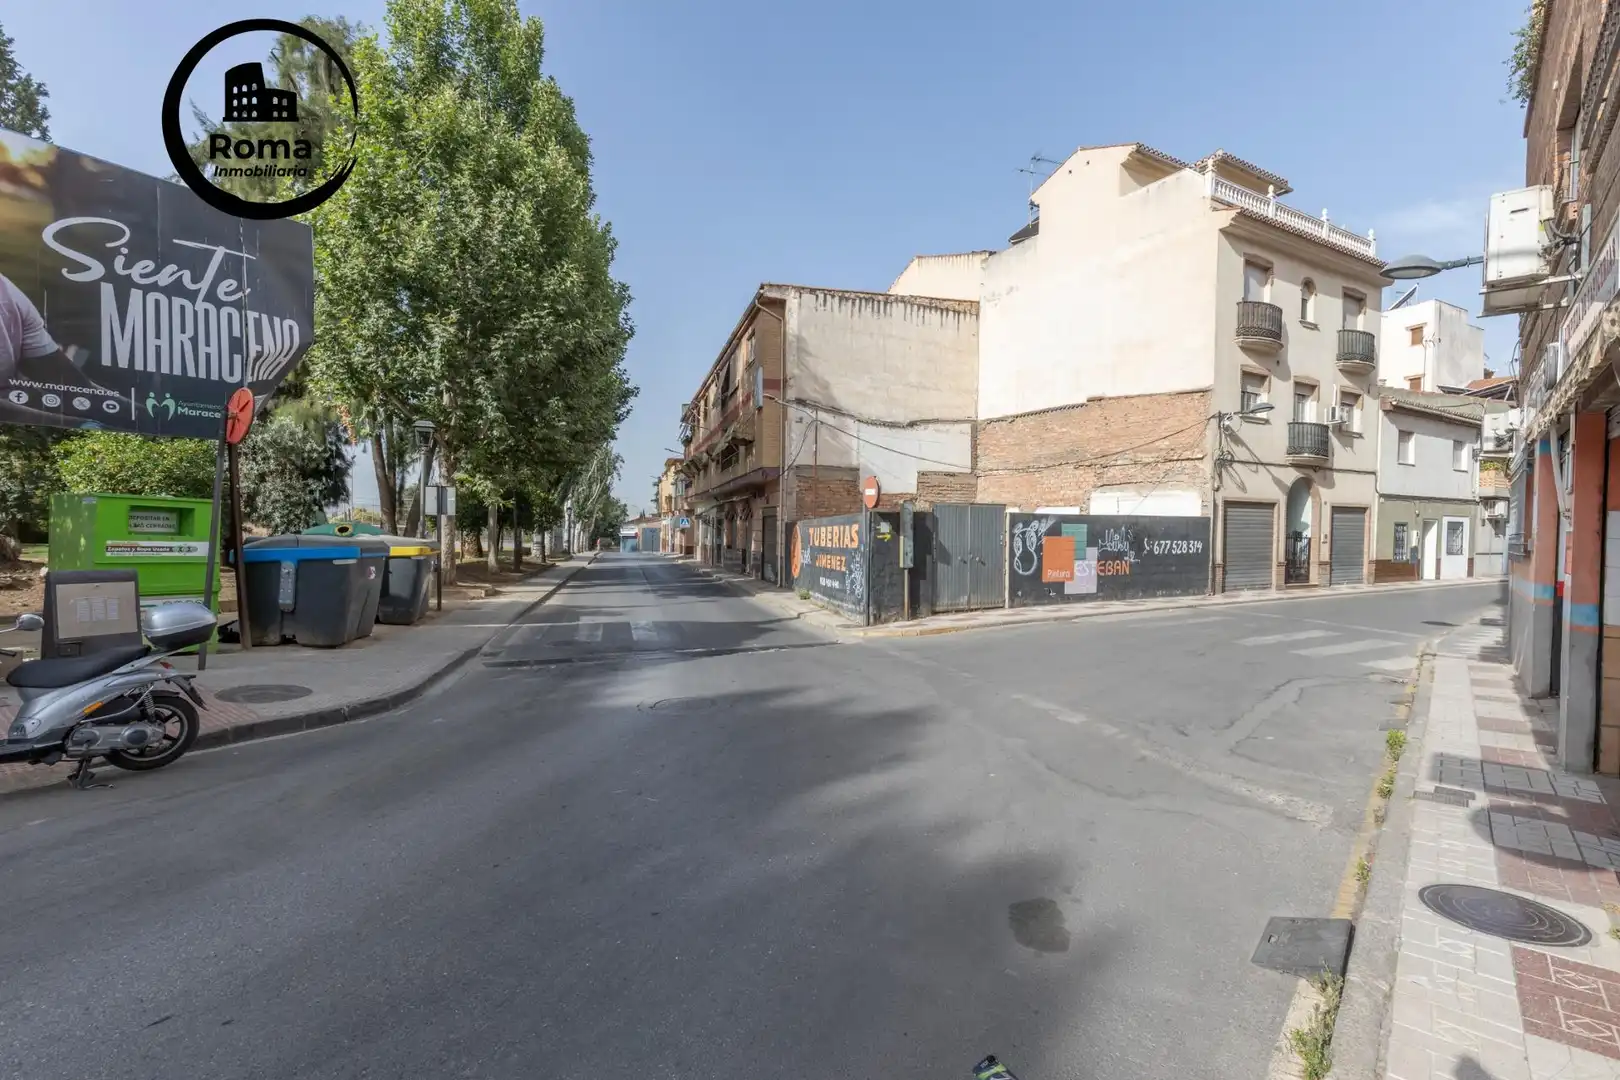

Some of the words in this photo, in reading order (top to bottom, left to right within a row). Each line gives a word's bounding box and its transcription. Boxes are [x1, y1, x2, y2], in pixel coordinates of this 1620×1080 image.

[100, 281, 300, 385] MARACENA
[8, 379, 120, 397] www.maracena.es
[178, 406, 221, 418] Marace
[809, 524, 859, 548] TUBERIAS
[816, 553, 846, 571] JIMENEZ
